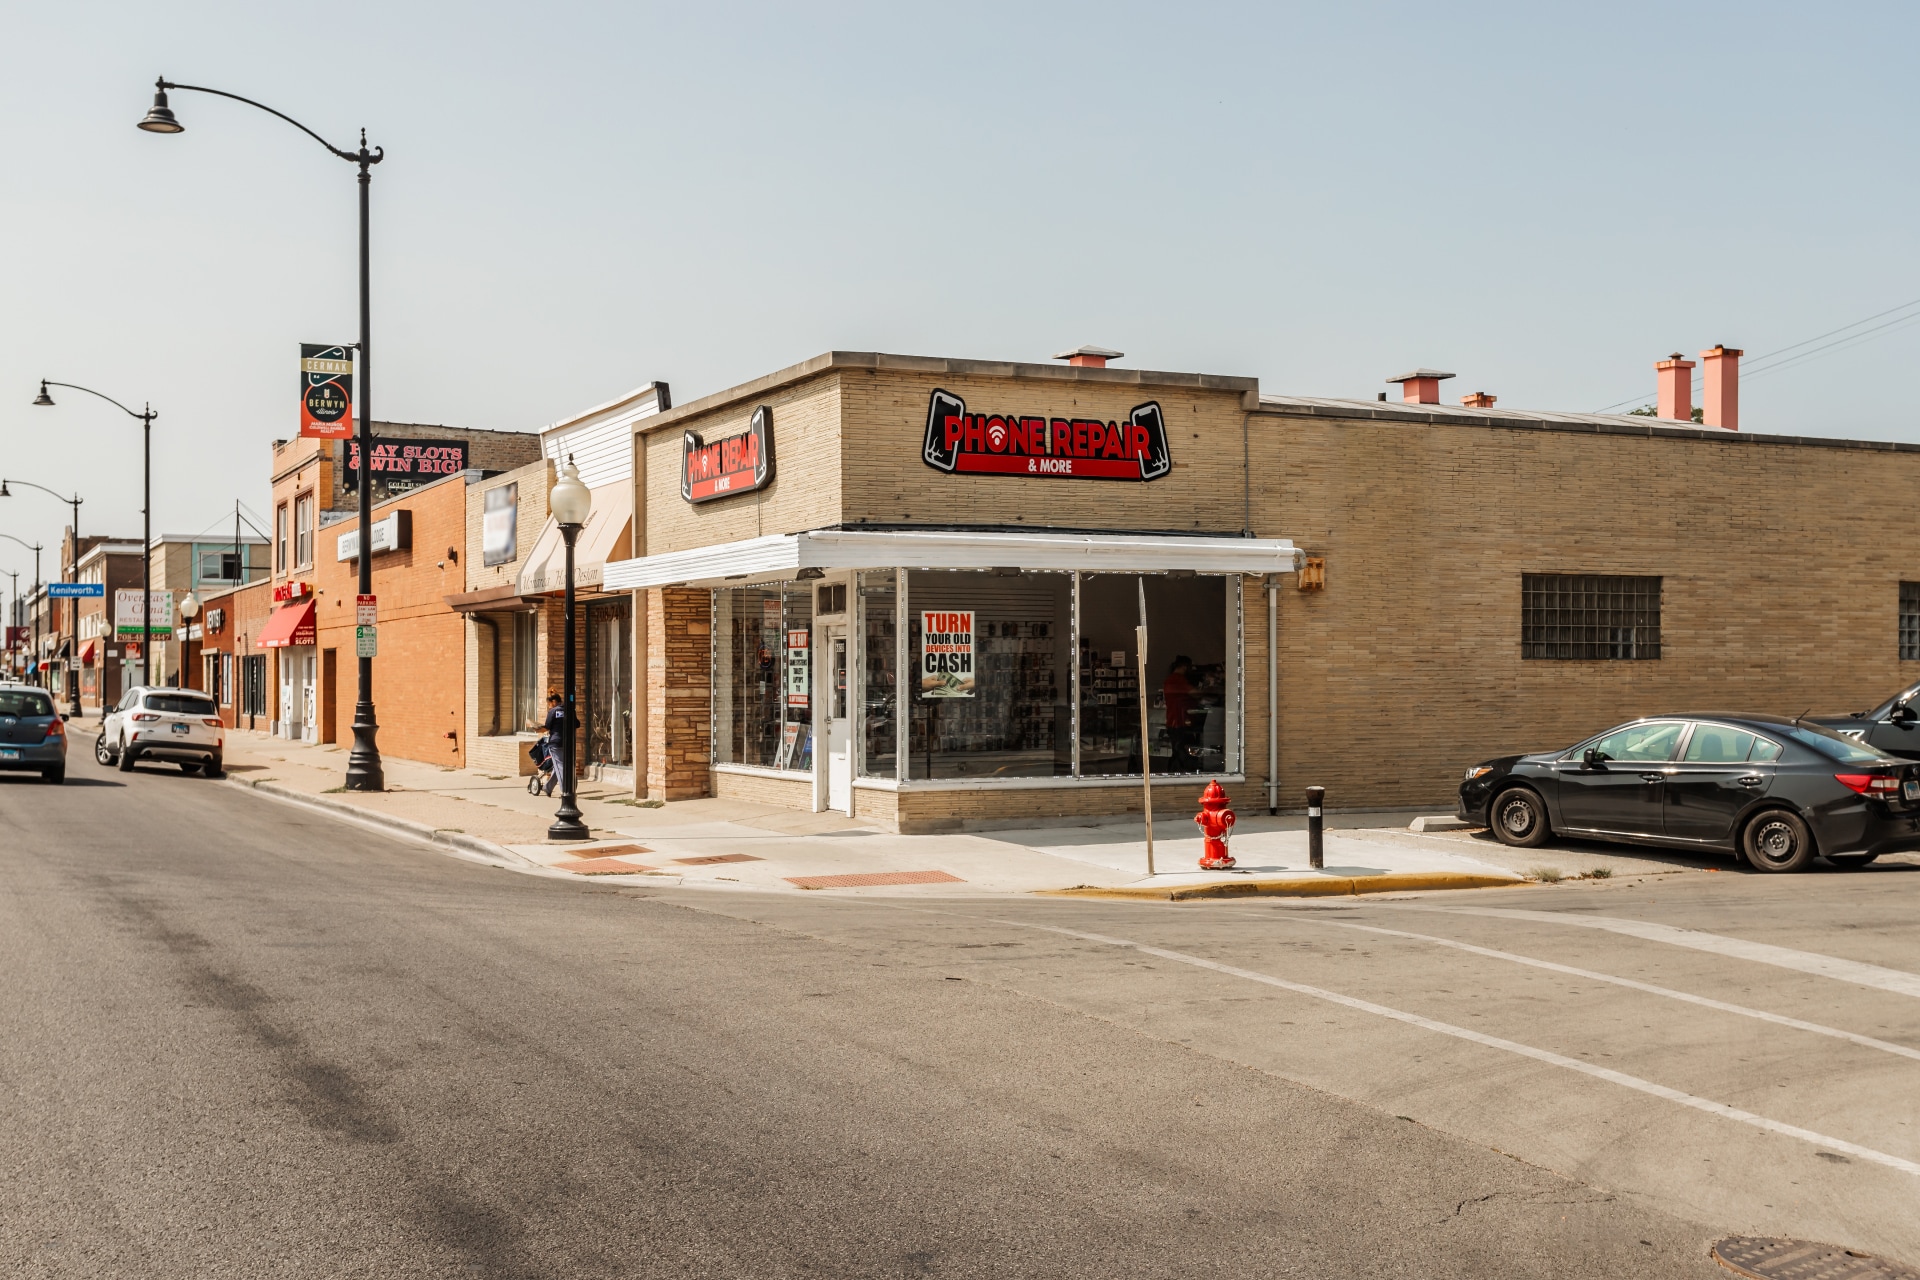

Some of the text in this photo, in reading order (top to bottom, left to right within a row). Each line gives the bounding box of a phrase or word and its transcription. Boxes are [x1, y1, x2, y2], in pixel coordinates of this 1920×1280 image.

[307, 361, 347, 372] CERMAK
[309, 398, 345, 408] BERWYN
[944, 415, 1151, 460] PHONE REPAIR
[349, 442, 462, 460] PAY SLOTS
[687, 433, 759, 483] PHONE REPAIR
[370, 457, 413, 472] WIN
[418, 459, 463, 474] BIG!
[1028, 460, 1072, 473] & MORE
[718, 477, 730, 491] MORE
[50, 586, 94, 595] Kenilworth
[118, 591, 164, 602] Overas
[131, 603, 163, 614] Chna
[925, 613, 971, 633] TURN
[357, 628, 363, 637] 2
[925, 633, 971, 644] YOUR OLD
[789, 633, 807, 646] WE BUY
[925, 653, 972, 673] CASH
